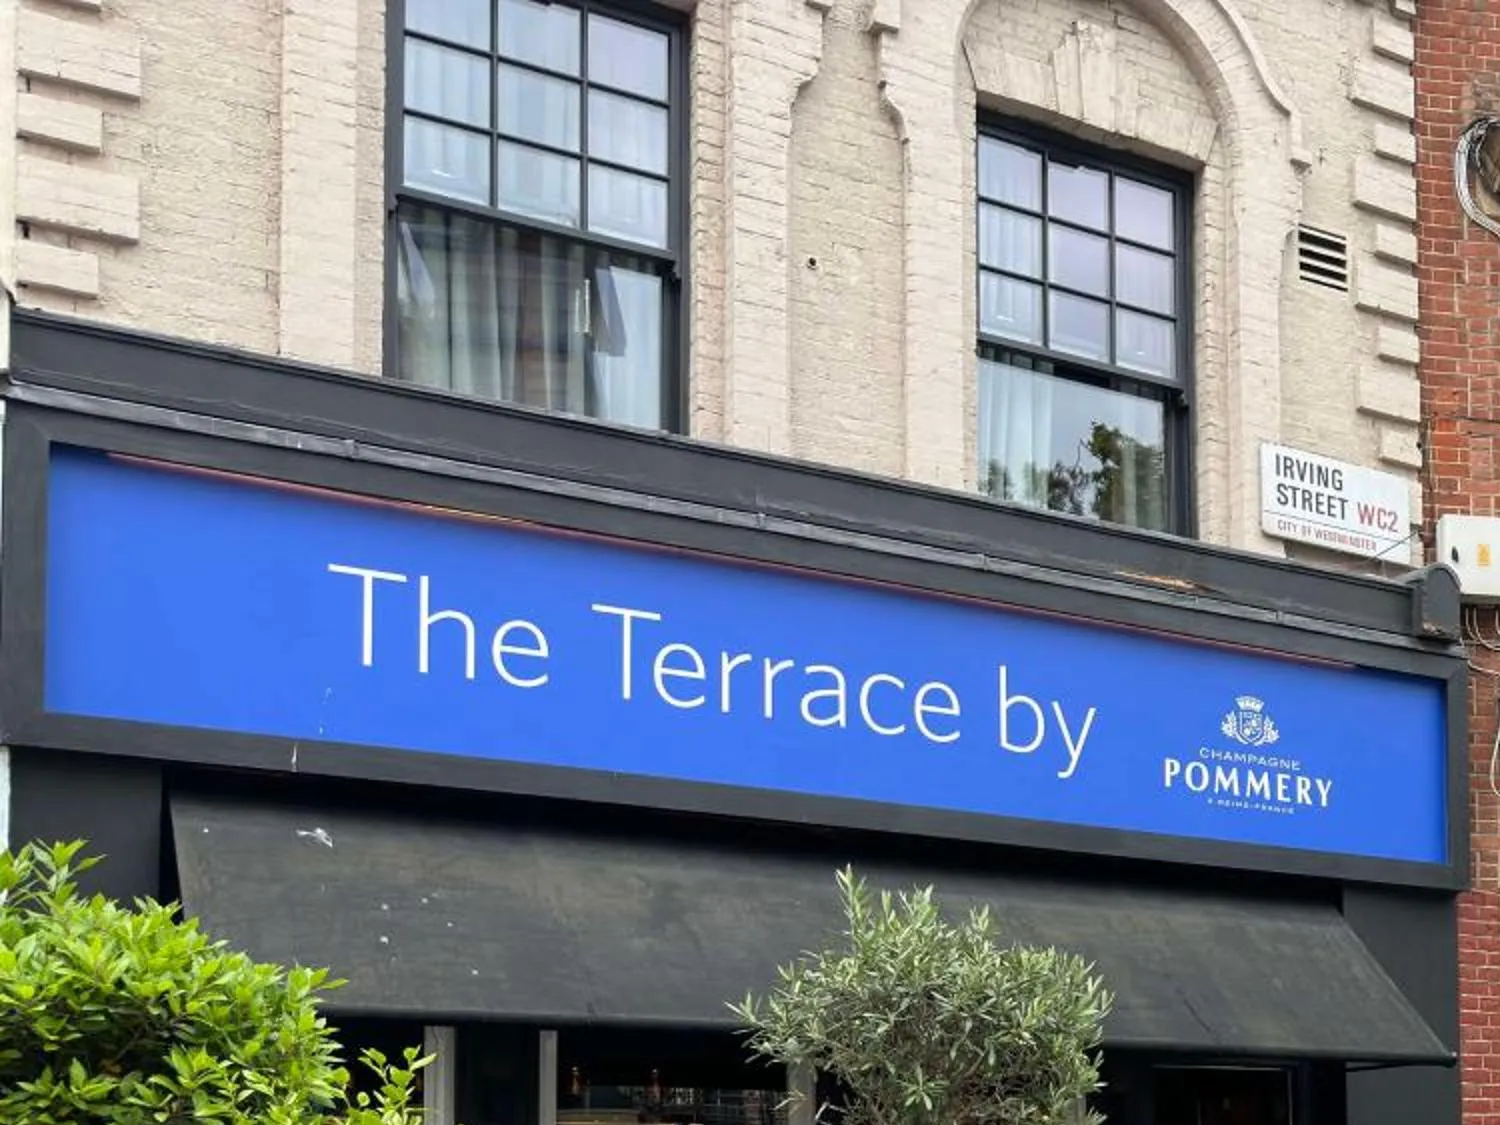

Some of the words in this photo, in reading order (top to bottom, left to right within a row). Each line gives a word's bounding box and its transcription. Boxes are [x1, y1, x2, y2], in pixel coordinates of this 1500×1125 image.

[1275, 453, 1344, 491] IRVING
[1276, 482, 1349, 521] STREET
[1357, 501, 1399, 534] WC2
[1277, 519, 1298, 533] CITY
[328, 562, 550, 689] The
[591, 603, 962, 744] Terrace
[999, 664, 1097, 780] by
[1199, 747, 1302, 771] CHAMPAGNE
[1163, 757, 1332, 807] POMMERY
